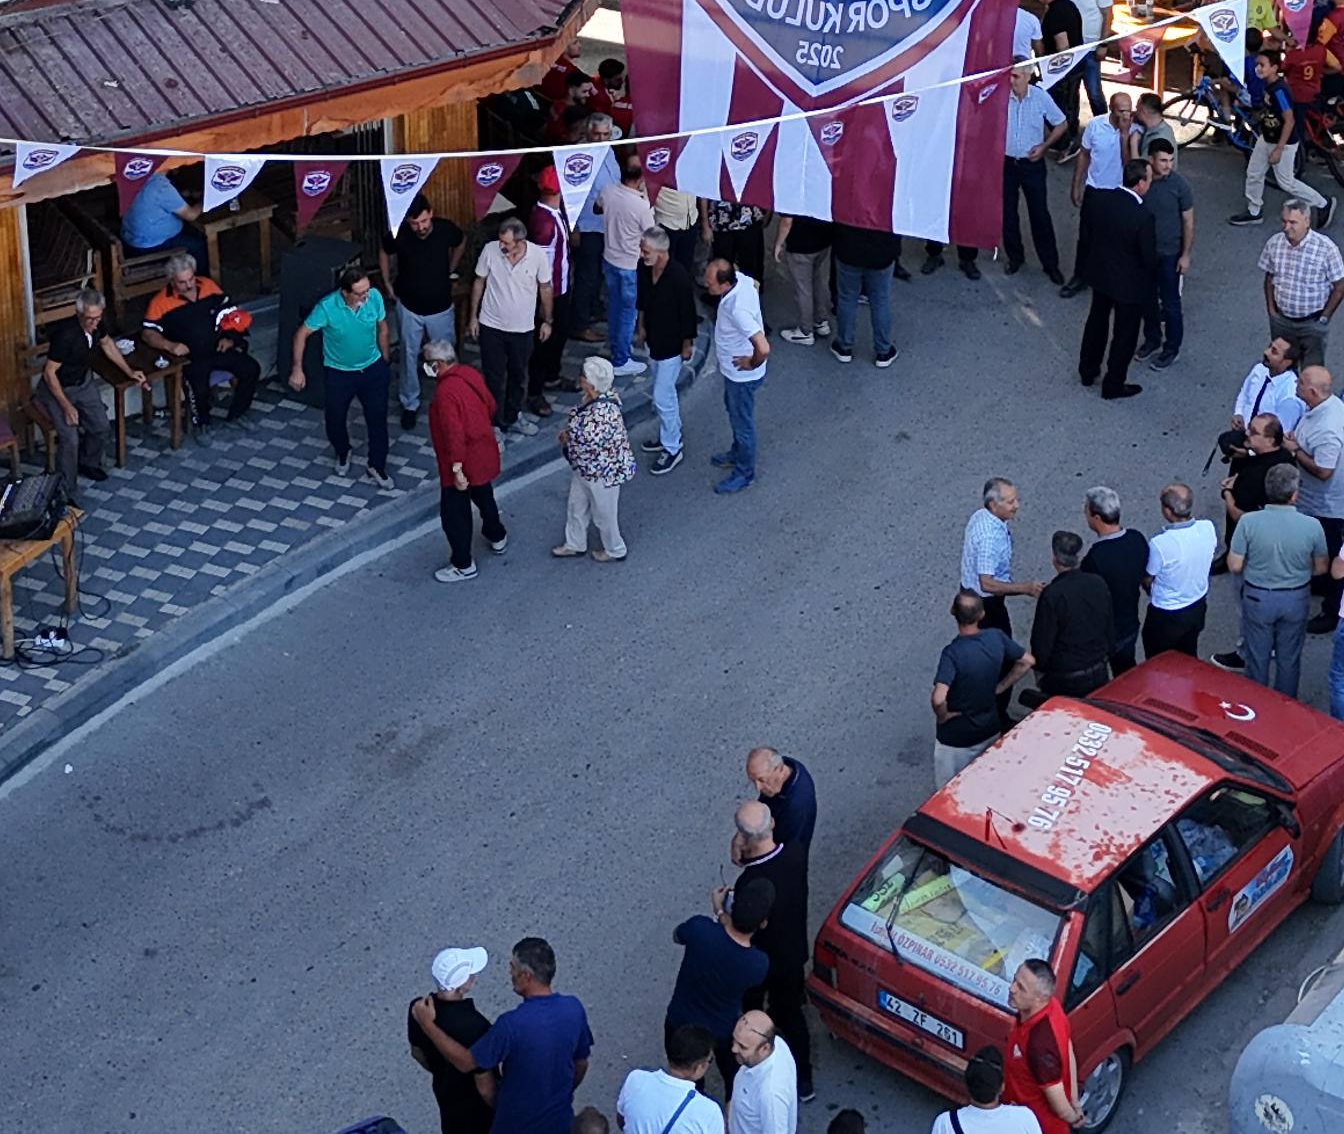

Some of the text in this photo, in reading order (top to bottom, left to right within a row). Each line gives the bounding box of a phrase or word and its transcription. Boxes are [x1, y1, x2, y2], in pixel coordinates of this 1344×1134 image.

[1303, 65, 1315, 81] 9
[1027, 722, 1113, 830] 0532 517 95 76
[886, 992, 902, 1010] 42
[912, 1010, 929, 1027] ZF
